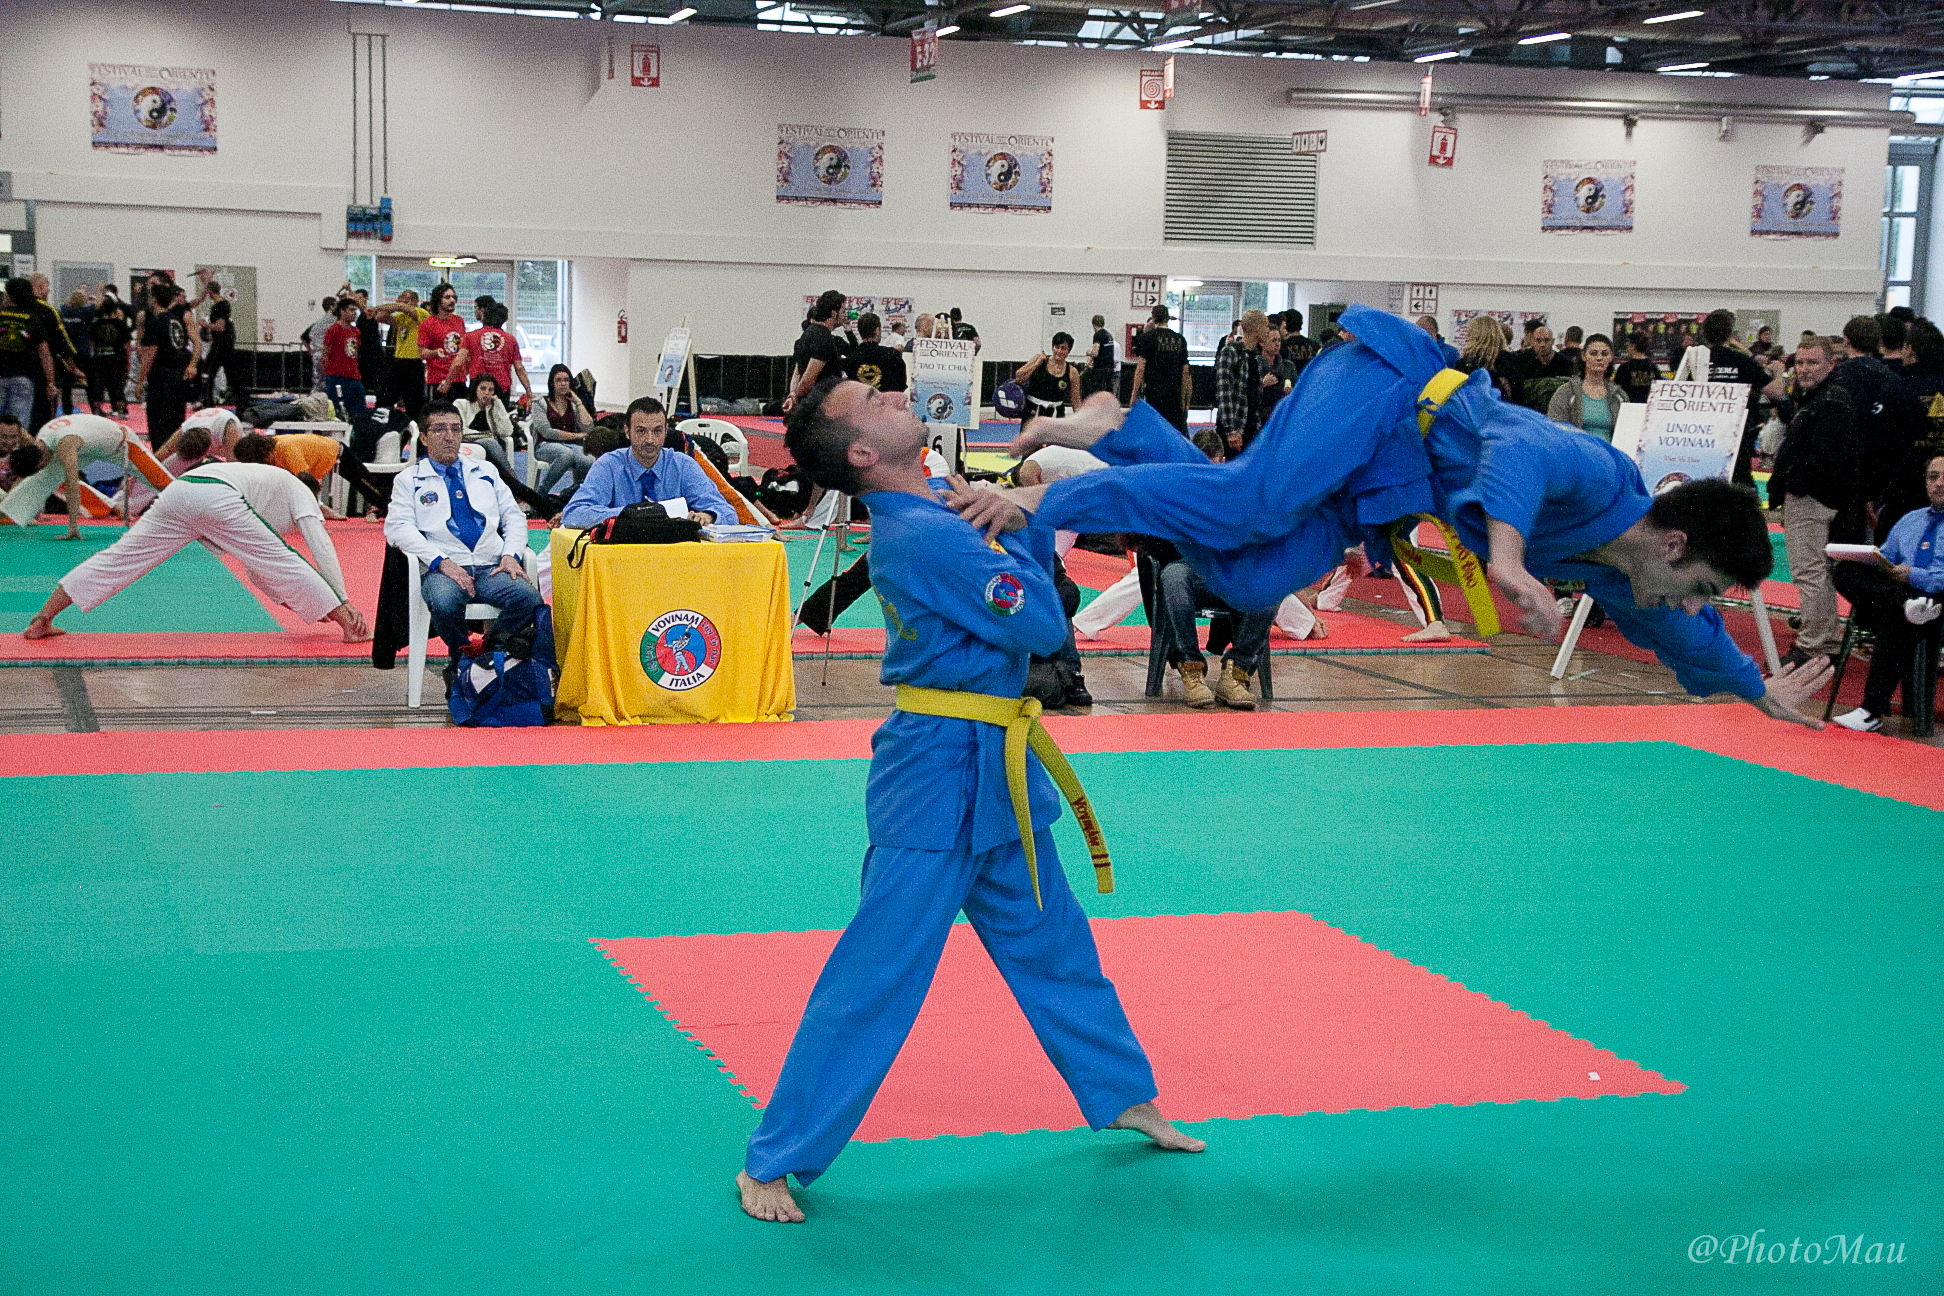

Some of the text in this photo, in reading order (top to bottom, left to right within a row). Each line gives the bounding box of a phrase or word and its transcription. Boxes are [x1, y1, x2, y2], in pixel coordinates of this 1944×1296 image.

[919, 339, 969, 351] FESTIVAL
[930, 349, 968, 358] ORIENTE
[937, 363, 946, 371] TE
[948, 364, 967, 372] CHIA
[1660, 383, 1738, 400] FESTIVAL
[1673, 398, 1737, 413] ORIENTE
[1666, 423, 1715, 435] UNIONE
[1659, 436, 1716, 449] VOVINAM
[651, 613, 700, 633] VOVINAM
[668, 672, 706, 688] ITALIA
